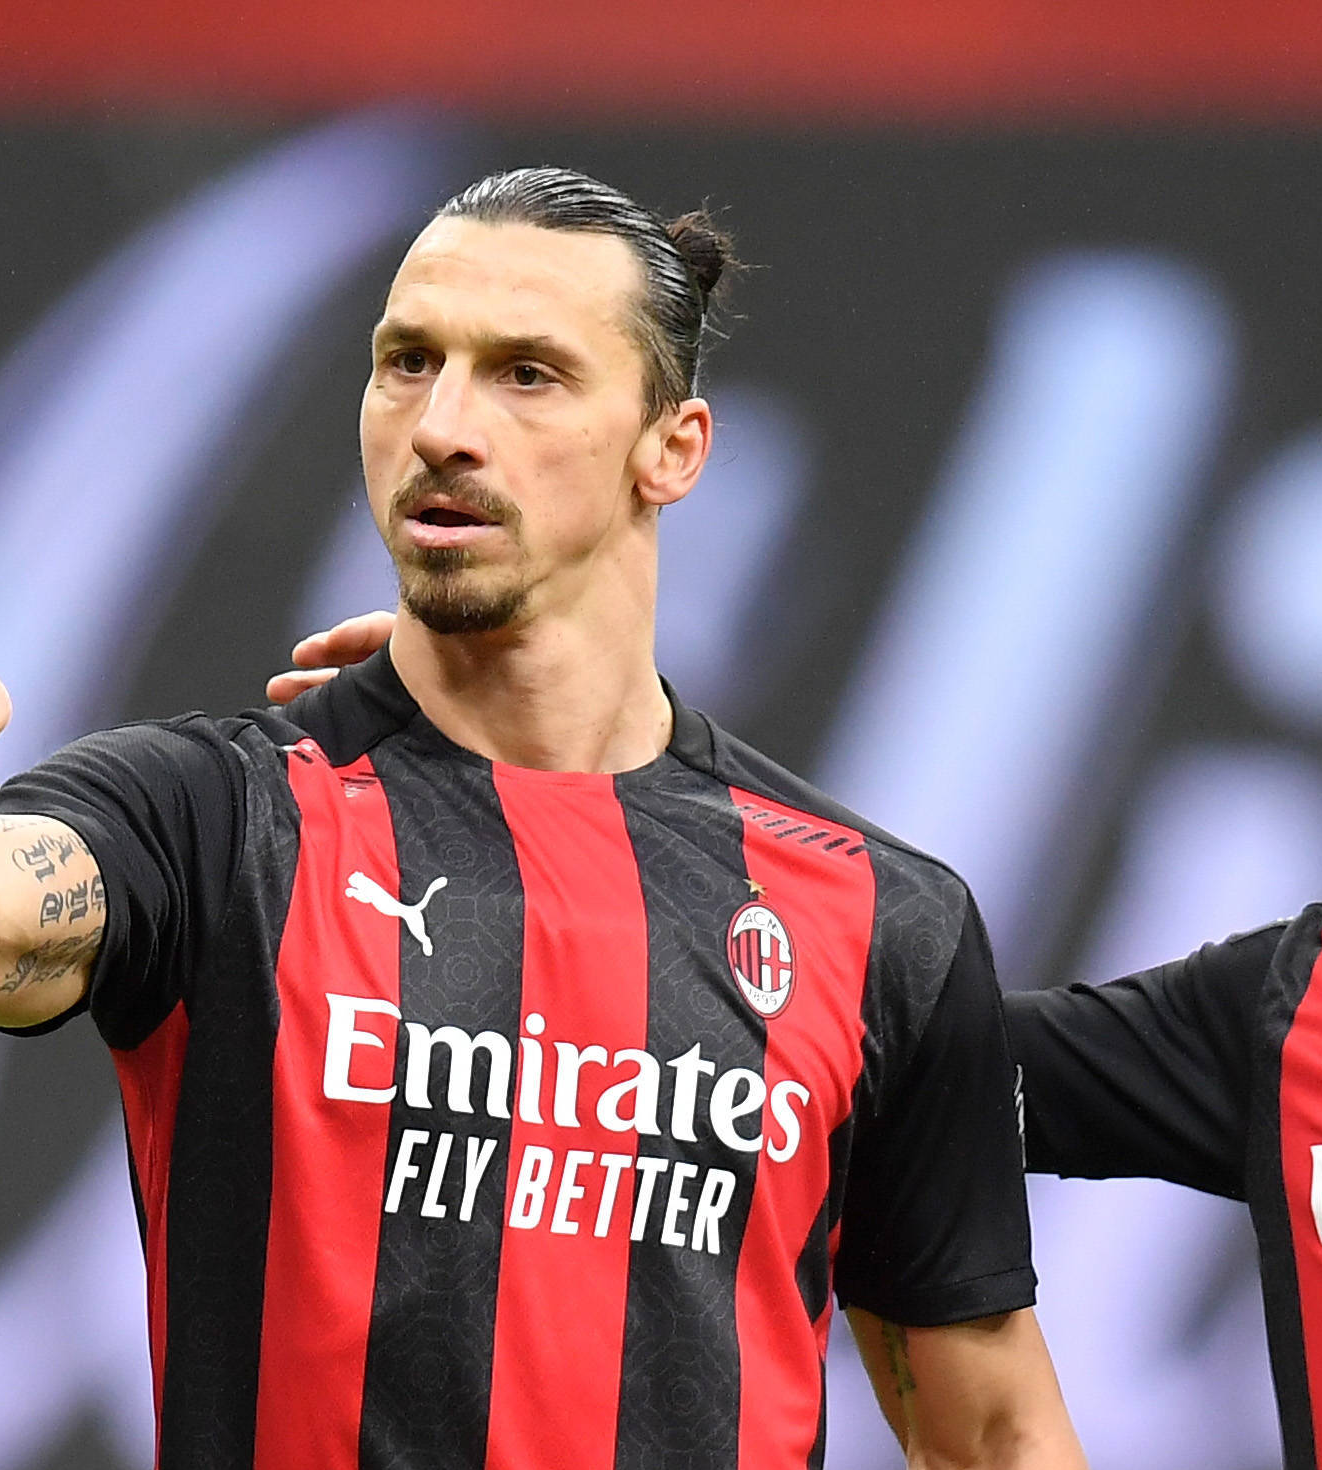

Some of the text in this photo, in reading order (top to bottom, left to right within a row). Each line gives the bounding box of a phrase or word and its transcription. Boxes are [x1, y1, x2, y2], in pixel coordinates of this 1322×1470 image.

[742, 910, 780, 934] ACM
[322, 992, 811, 1163] Emirates
[383, 1128, 737, 1256] FLY BETTER
